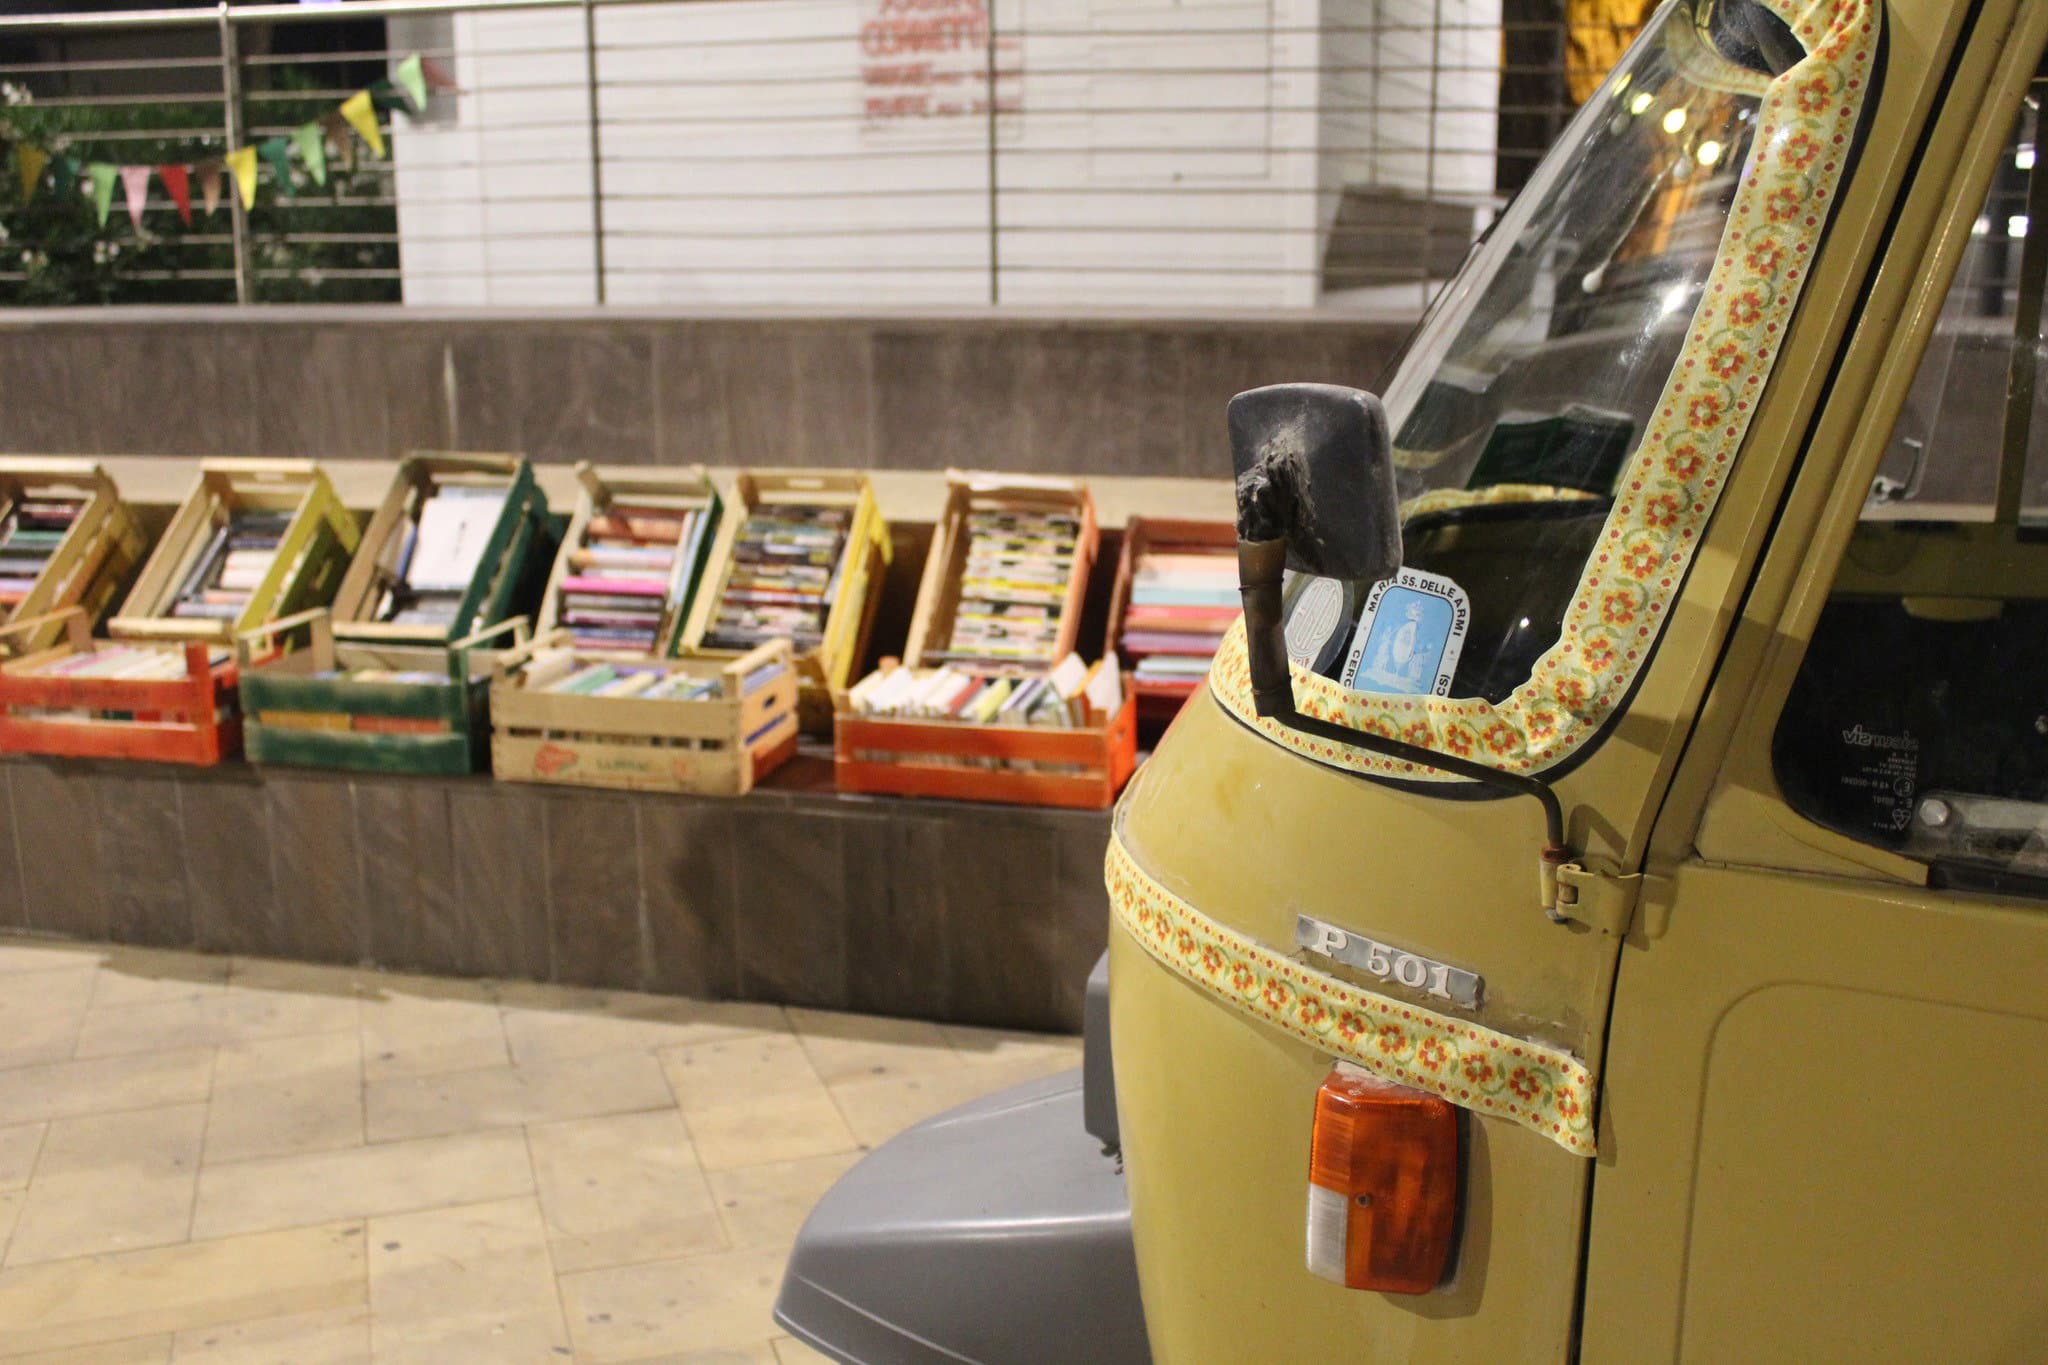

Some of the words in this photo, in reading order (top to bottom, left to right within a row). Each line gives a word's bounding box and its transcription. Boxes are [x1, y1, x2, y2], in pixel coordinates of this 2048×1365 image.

[1368, 575, 1398, 612] MARIA
[1402, 575, 1418, 588] SS.
[1420, 579, 1456, 599] DELLE
[1454, 597, 1467, 637] ARMI
[1312, 927, 1349, 958] P
[1368, 943, 1452, 1000] 501
